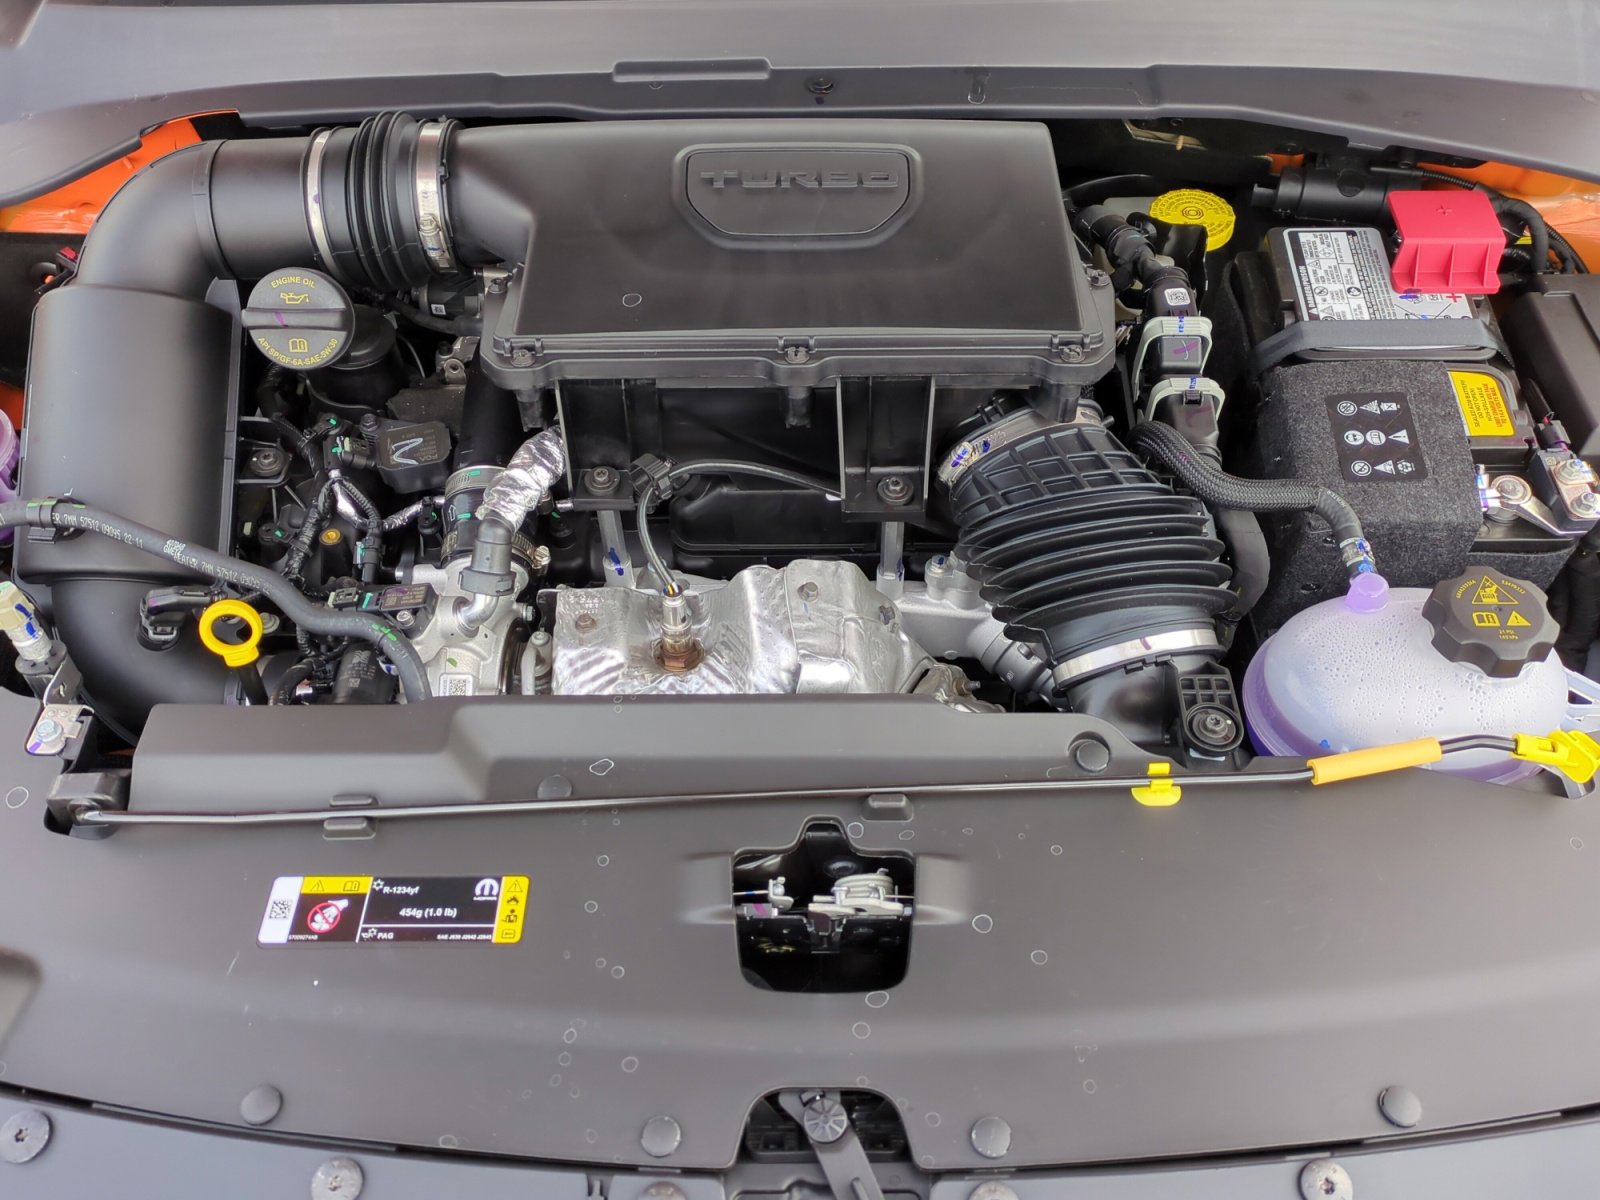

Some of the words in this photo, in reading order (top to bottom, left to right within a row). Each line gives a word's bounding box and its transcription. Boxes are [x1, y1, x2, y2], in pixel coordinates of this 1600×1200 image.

[700, 170, 898, 188] TURBO
[271, 276, 300, 288] ENGINE
[302, 278, 316, 288] OIL
[258, 338, 270, 350] API
[383, 886, 420, 896] R-1234yf
[399, 908, 422, 918] 454g
[424, 908, 442, 918] (1.0
[444, 908, 458, 918] lb)
[377, 932, 394, 940] PAG
